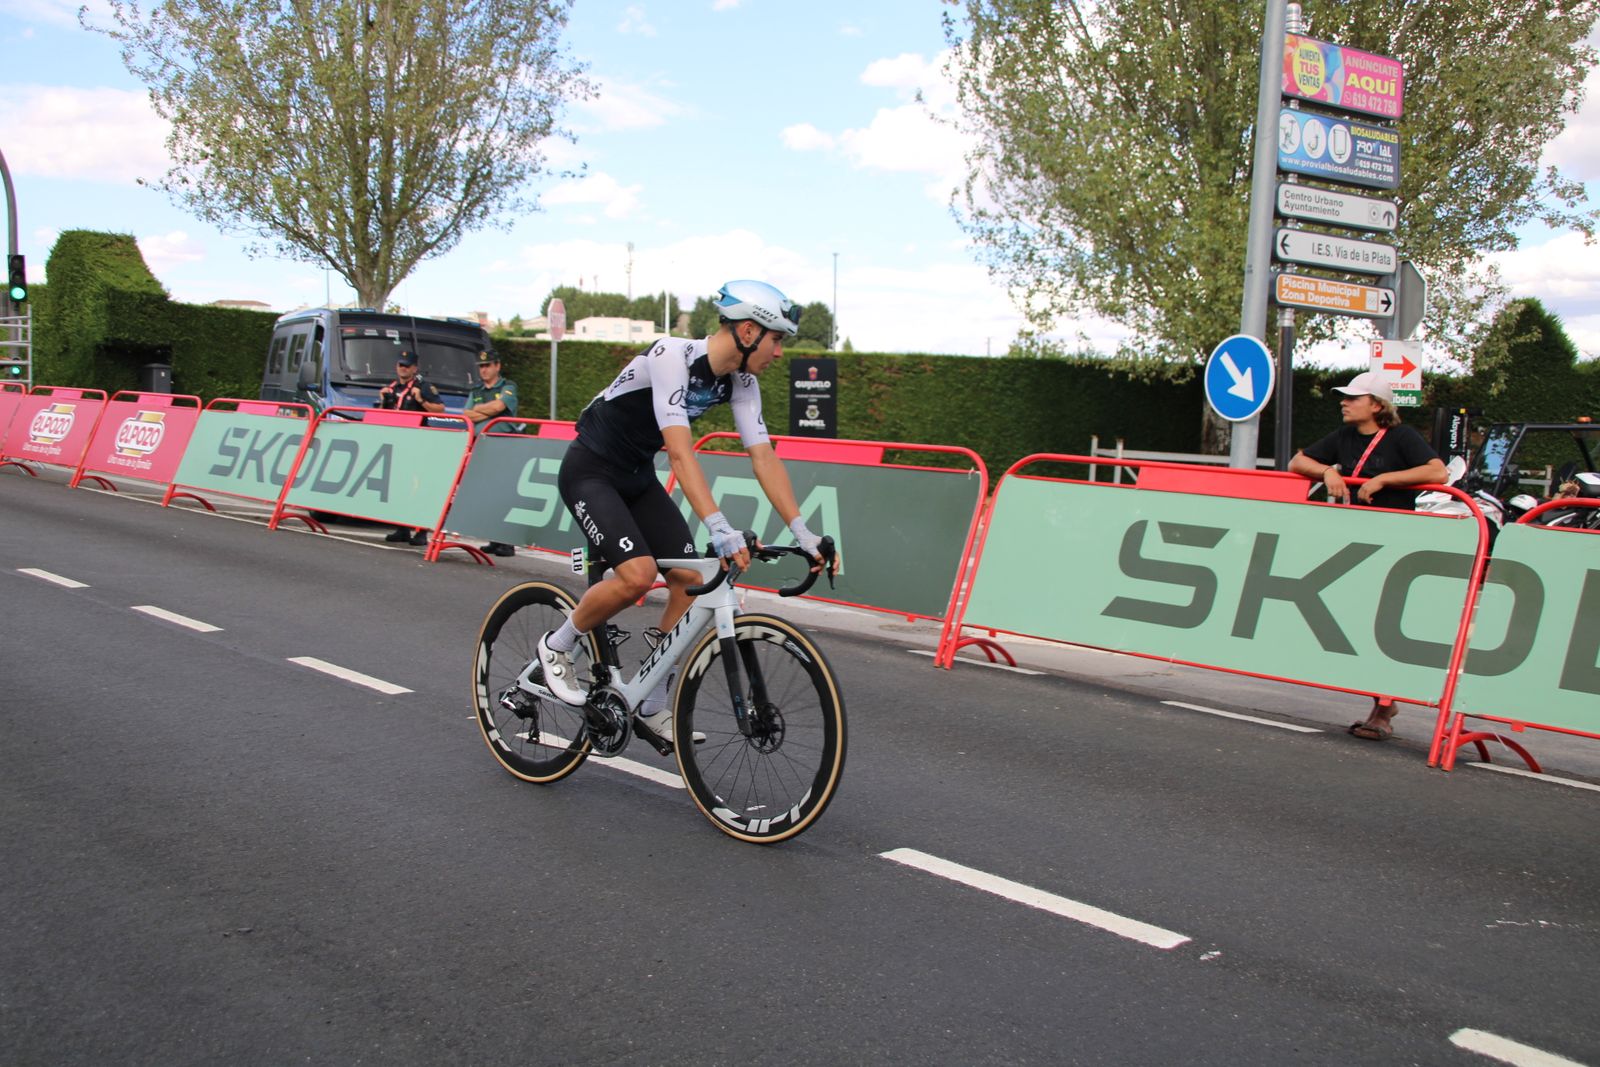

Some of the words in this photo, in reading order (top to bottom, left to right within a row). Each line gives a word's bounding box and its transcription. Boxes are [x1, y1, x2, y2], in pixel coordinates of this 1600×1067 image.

[1300, 61, 1320, 76] TUS
[1299, 74, 1320, 89] VENTAS
[1346, 72, 1397, 97] AQUÍ
[1281, 157, 1394, 182] www.provialbiosaludables.com
[1284, 189, 1313, 203] Centro
[1315, 194, 1344, 208] Urbano
[1284, 200, 1340, 217] Ayuntamiento
[1312, 242, 1333, 257] I.E.S.
[1350, 248, 1360, 261] de
[1362, 250, 1370, 262] la
[1371, 251, 1391, 265] Plata
[1281, 288, 1306, 301] Zona
[1307, 292, 1350, 307] Deportiva
[1283, 277, 1316, 291] Piscina
[1318, 282, 1360, 298] Municipal
[582, 513, 605, 546] UBS
[639, 605, 694, 684] SCOTT
